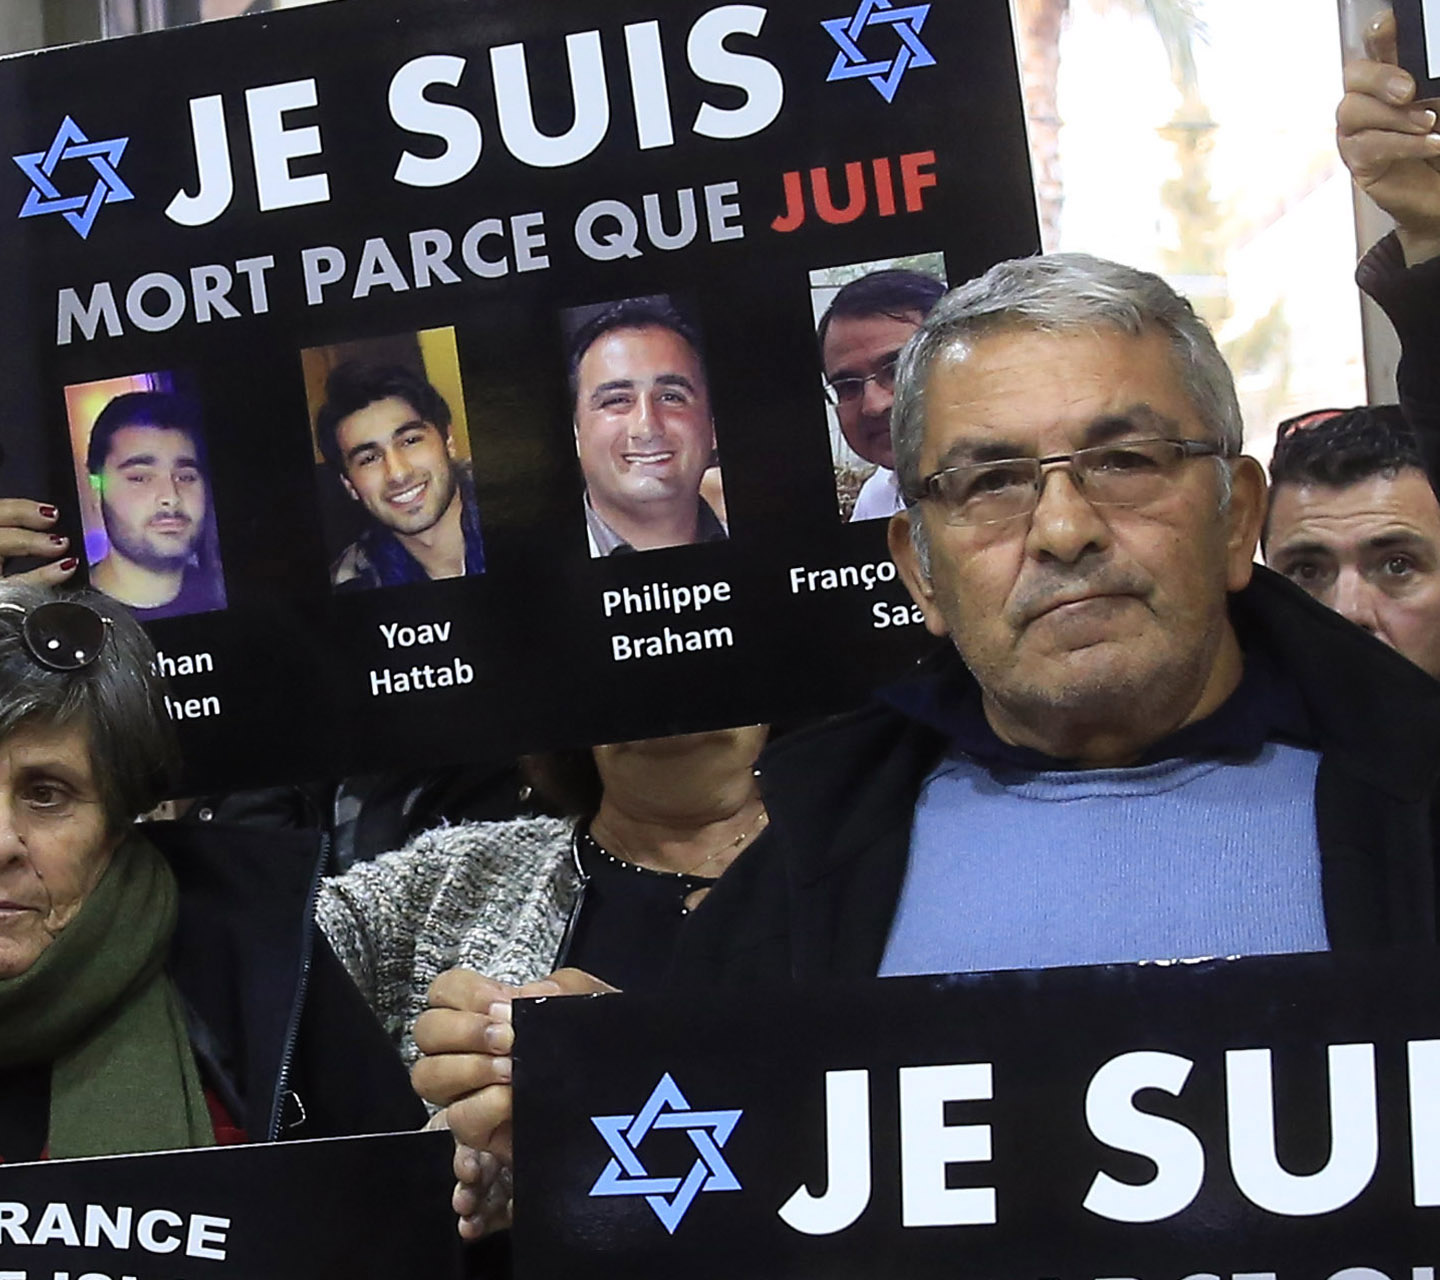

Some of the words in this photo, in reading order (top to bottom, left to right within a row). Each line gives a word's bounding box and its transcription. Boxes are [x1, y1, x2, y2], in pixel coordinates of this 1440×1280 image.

[166, 78, 330, 226] JE
[389, 5, 783, 186] SUIS
[58, 256, 274, 344] MORT
[302, 212, 550, 305] PARCE
[575, 182, 744, 260] QUE
[772, 151, 936, 232] JUIF
[604, 582, 730, 616] Philippe
[380, 622, 450, 648] Yoav
[612, 628, 732, 660] Braham
[370, 658, 472, 695] Hattab
[778, 1064, 996, 1234] JE
